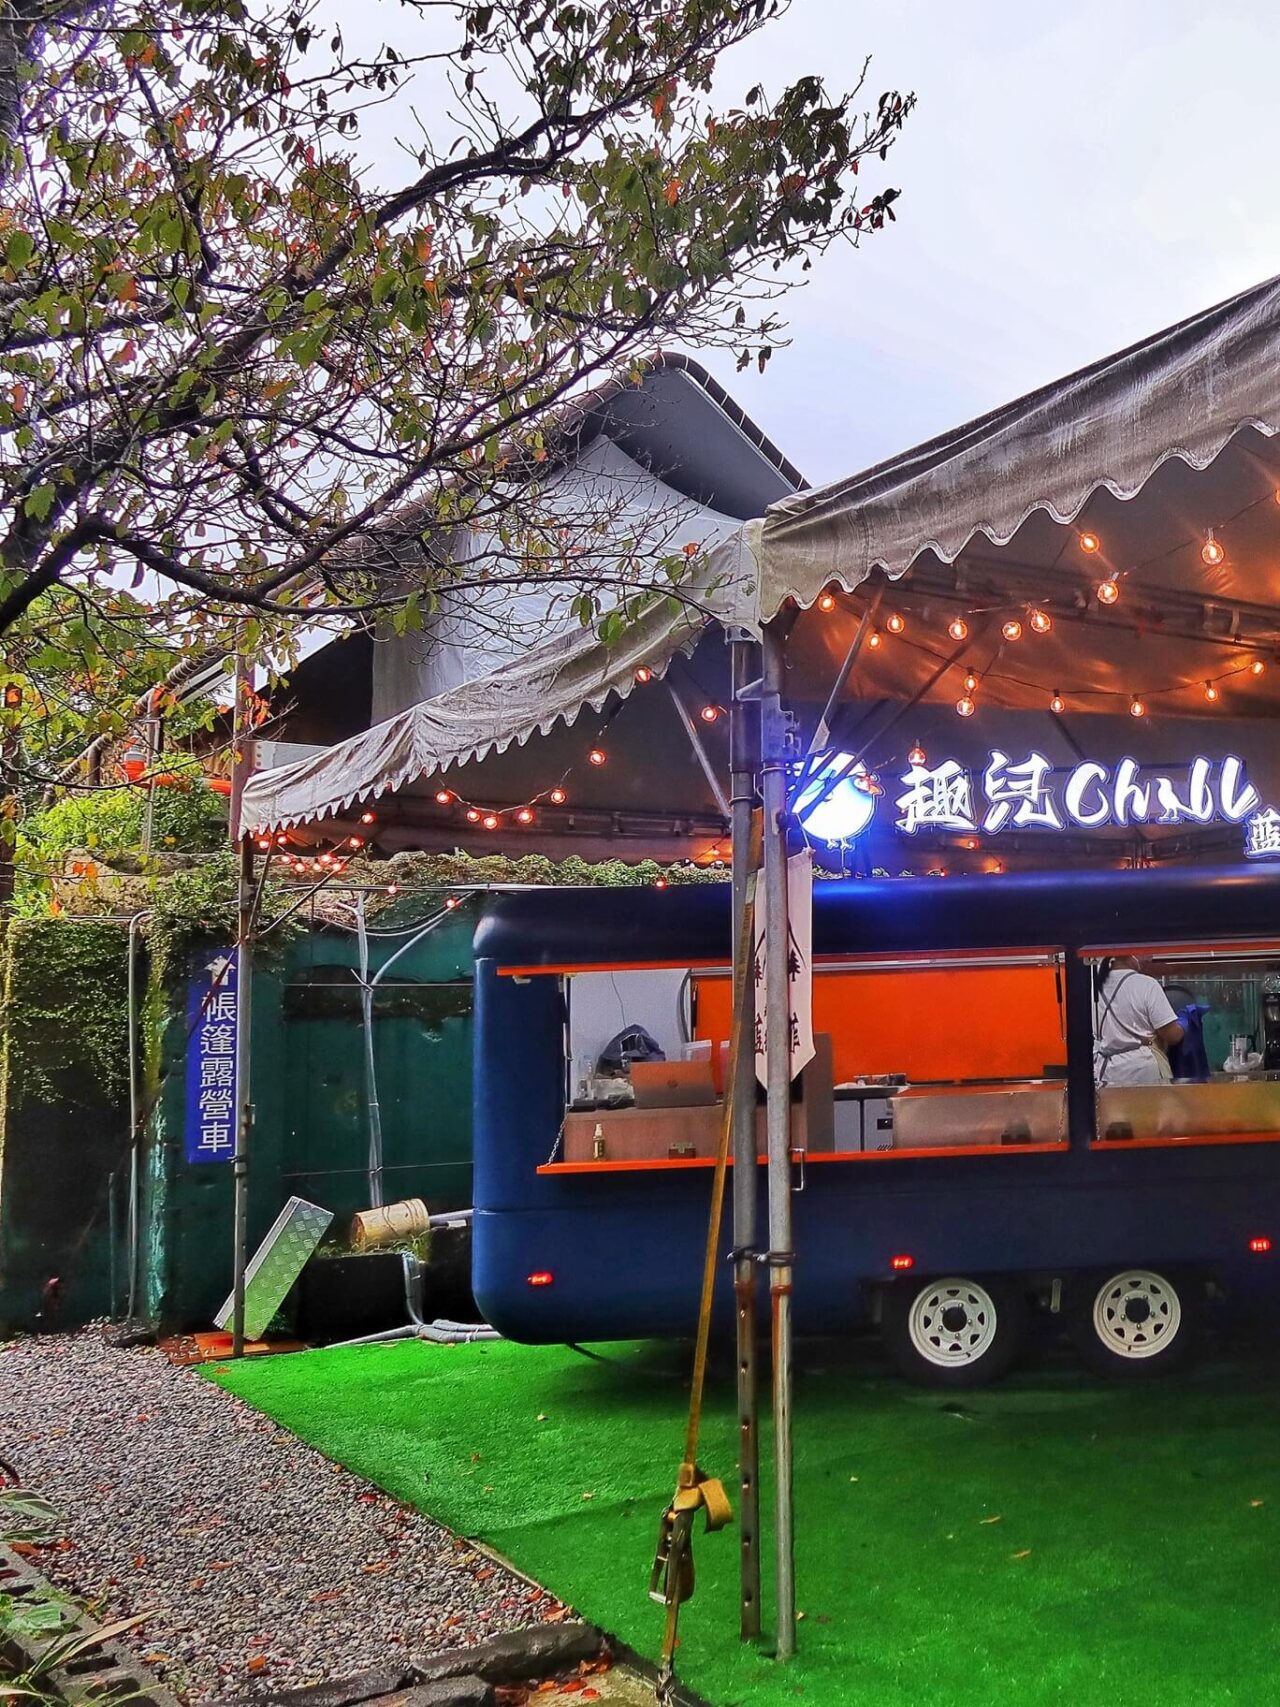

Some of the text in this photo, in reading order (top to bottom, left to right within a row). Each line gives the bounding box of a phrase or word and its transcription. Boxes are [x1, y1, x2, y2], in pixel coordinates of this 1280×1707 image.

[198, 991, 237, 1153] 帳篷露營車
